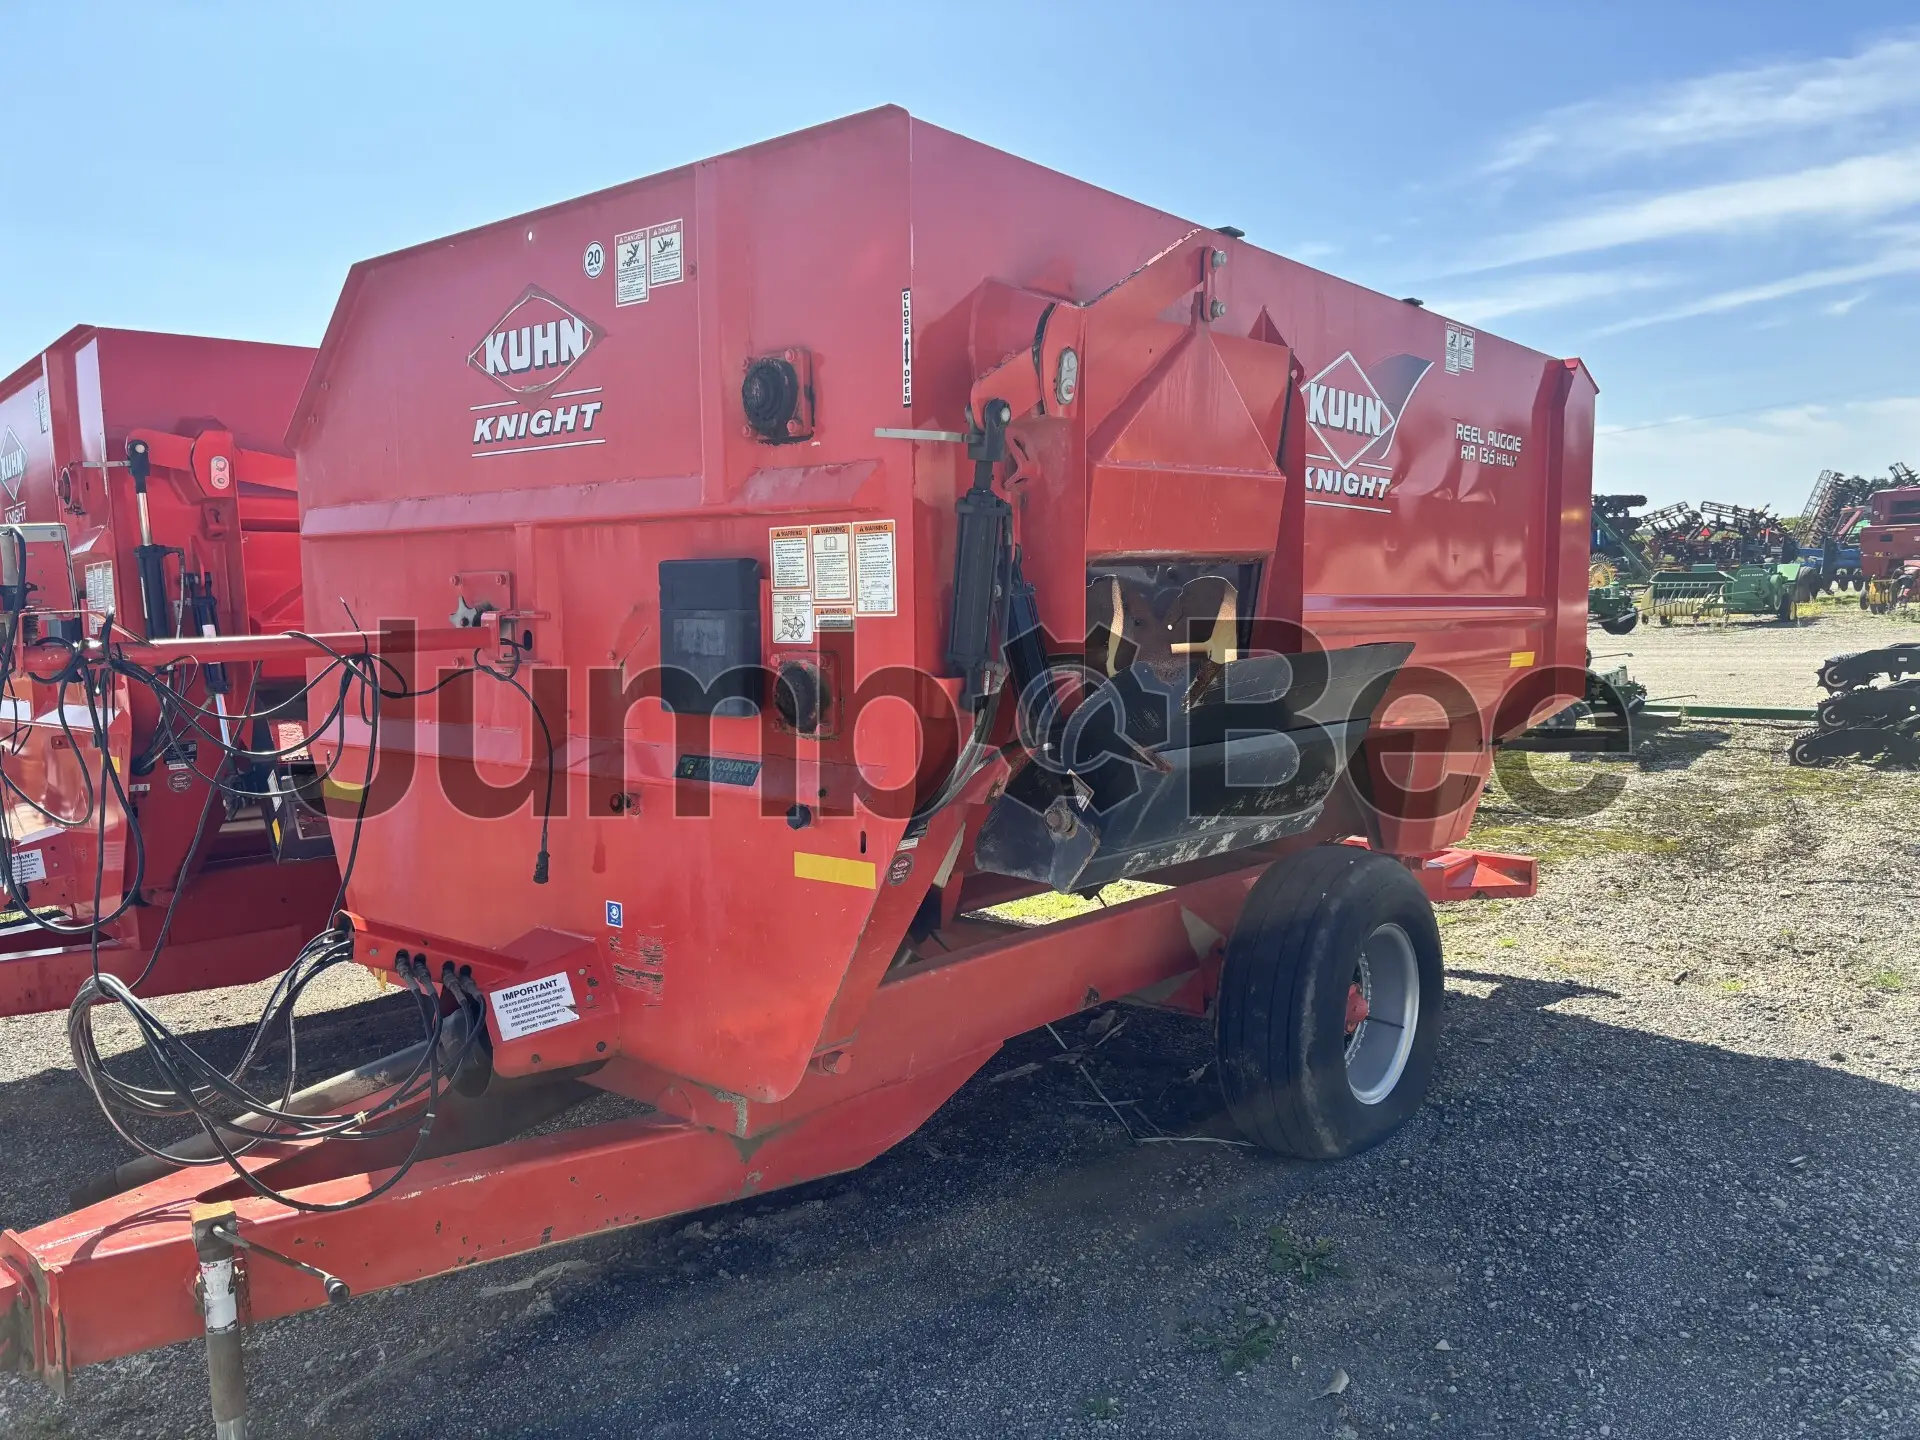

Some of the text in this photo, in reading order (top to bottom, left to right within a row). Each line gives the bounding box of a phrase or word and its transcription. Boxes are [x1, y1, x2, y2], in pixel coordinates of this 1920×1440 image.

[623, 232, 644, 242] DANGER
[657, 224, 678, 235] DANGER
[587, 249, 601, 266] 20
[485, 317, 584, 375] KUHN
[1309, 382, 1381, 437] KUHN
[472, 401, 602, 444] KNIGHT
[1456, 423, 1522, 452] REEL AUGGIE
[1, 449, 23, 481] KUHN
[1460, 445, 1476, 459] RA
[1479, 447, 1495, 465] 136
[1305, 466, 1391, 500] KNIGHT
[716, 760, 757, 773] COUNTY
[502, 979, 558, 1001] IMPORTANT
[499, 1001, 517, 1009] ALWAYS
[517, 996, 536, 1005] REDUCE
[522, 1002, 540, 1010] BEFORE
[521, 1023, 538, 1031] BEFORE
